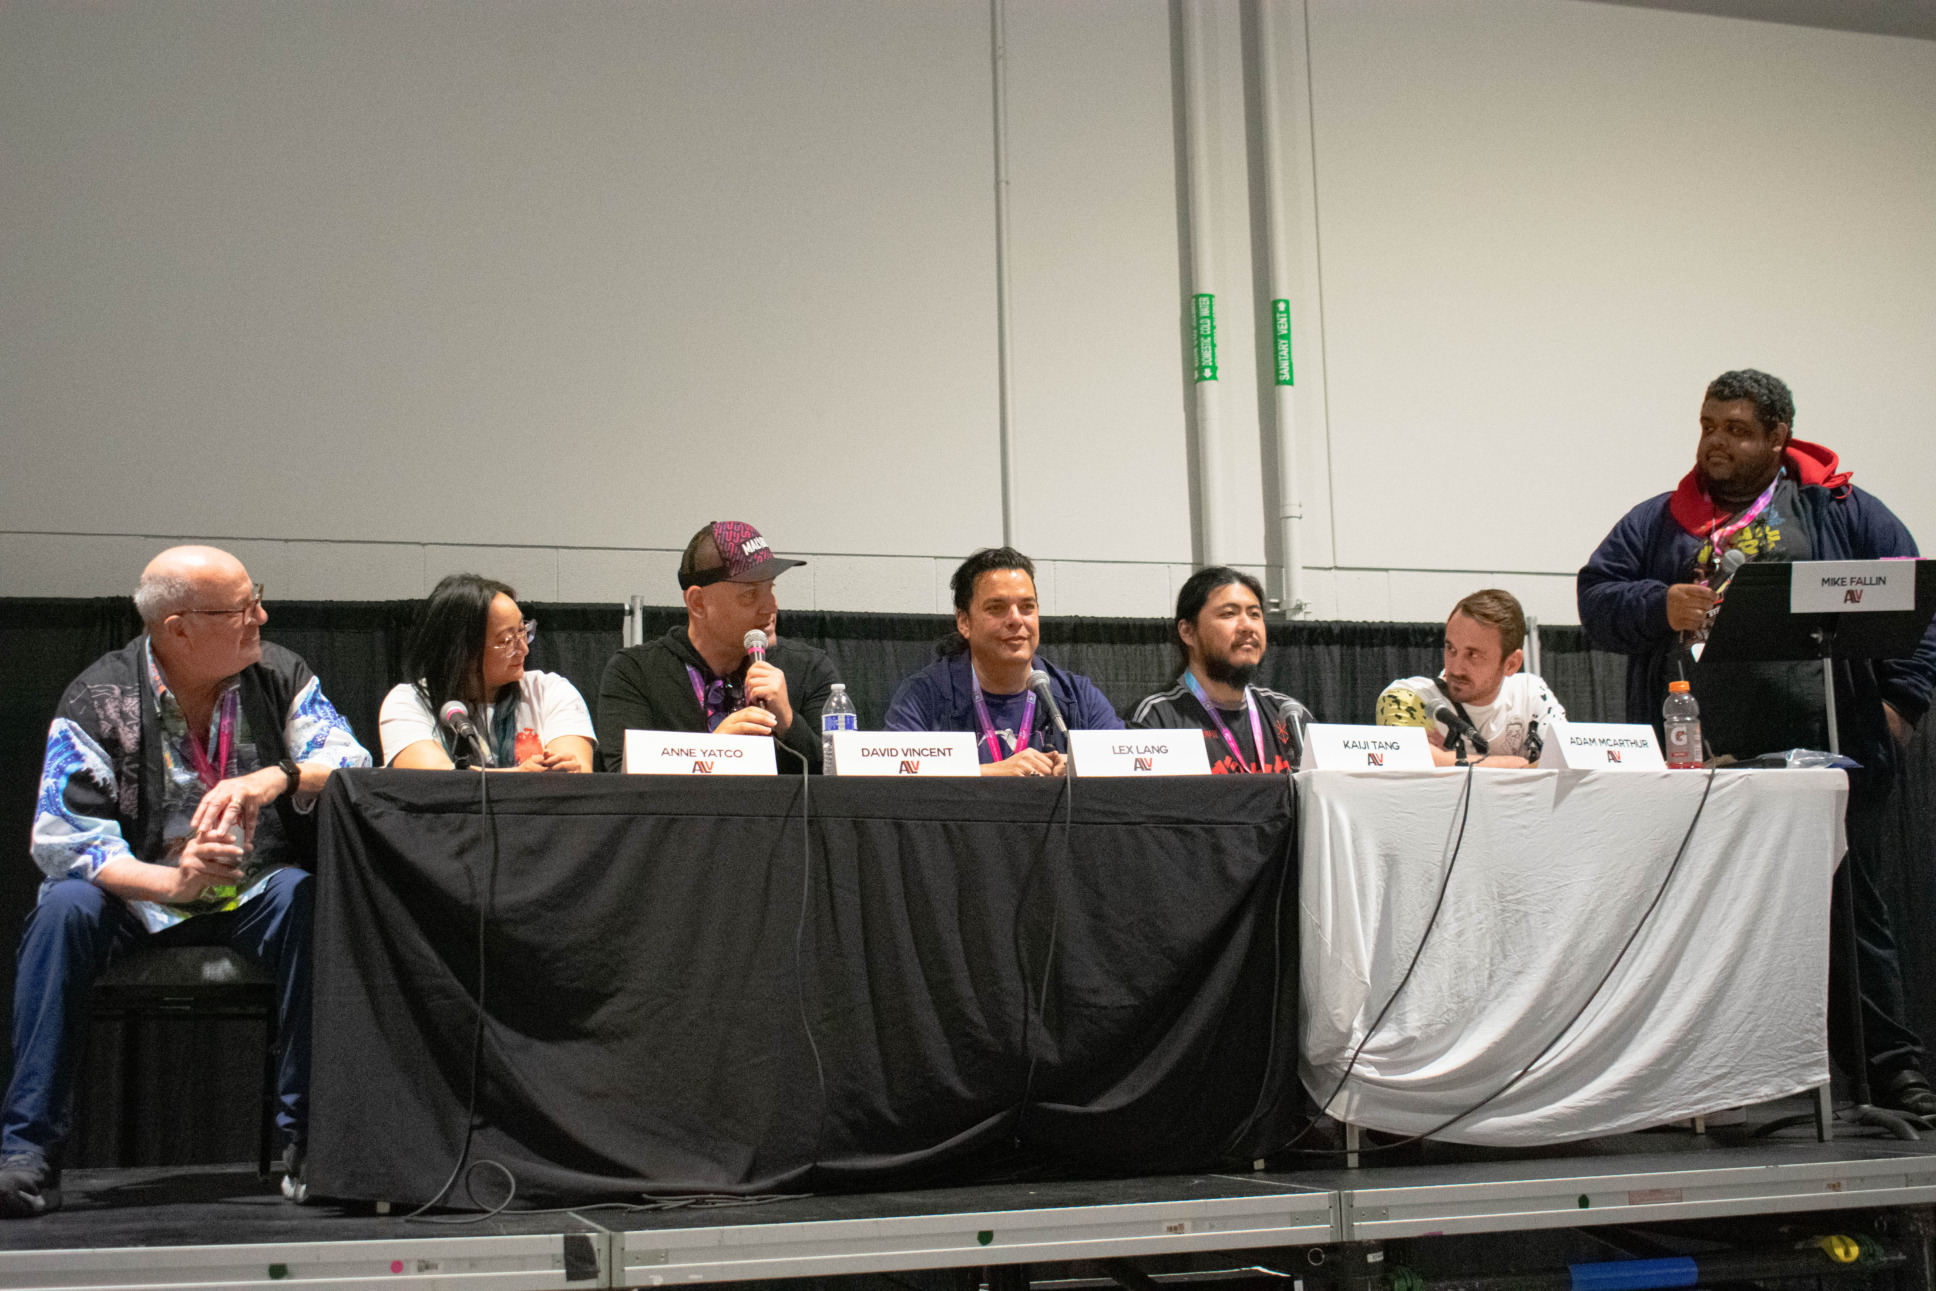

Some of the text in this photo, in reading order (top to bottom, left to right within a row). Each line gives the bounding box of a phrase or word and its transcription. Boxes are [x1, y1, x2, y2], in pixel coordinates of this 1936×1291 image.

[1198, 297, 1213, 366] DOMESTIC COLD WATER
[1276, 313, 1290, 381] SANITARY VENT
[1821, 576, 1887, 587] MIKE FALLIN
[1670, 726, 1688, 746] G
[1343, 740, 1401, 751] KAIJI TANG
[1570, 736, 1650, 749] ADAM MCARTHUR
[661, 747, 744, 758] ANNE YATCO
[861, 747, 954, 757] DAVID VINCENT
[1112, 745, 1169, 755] LEX LANG
